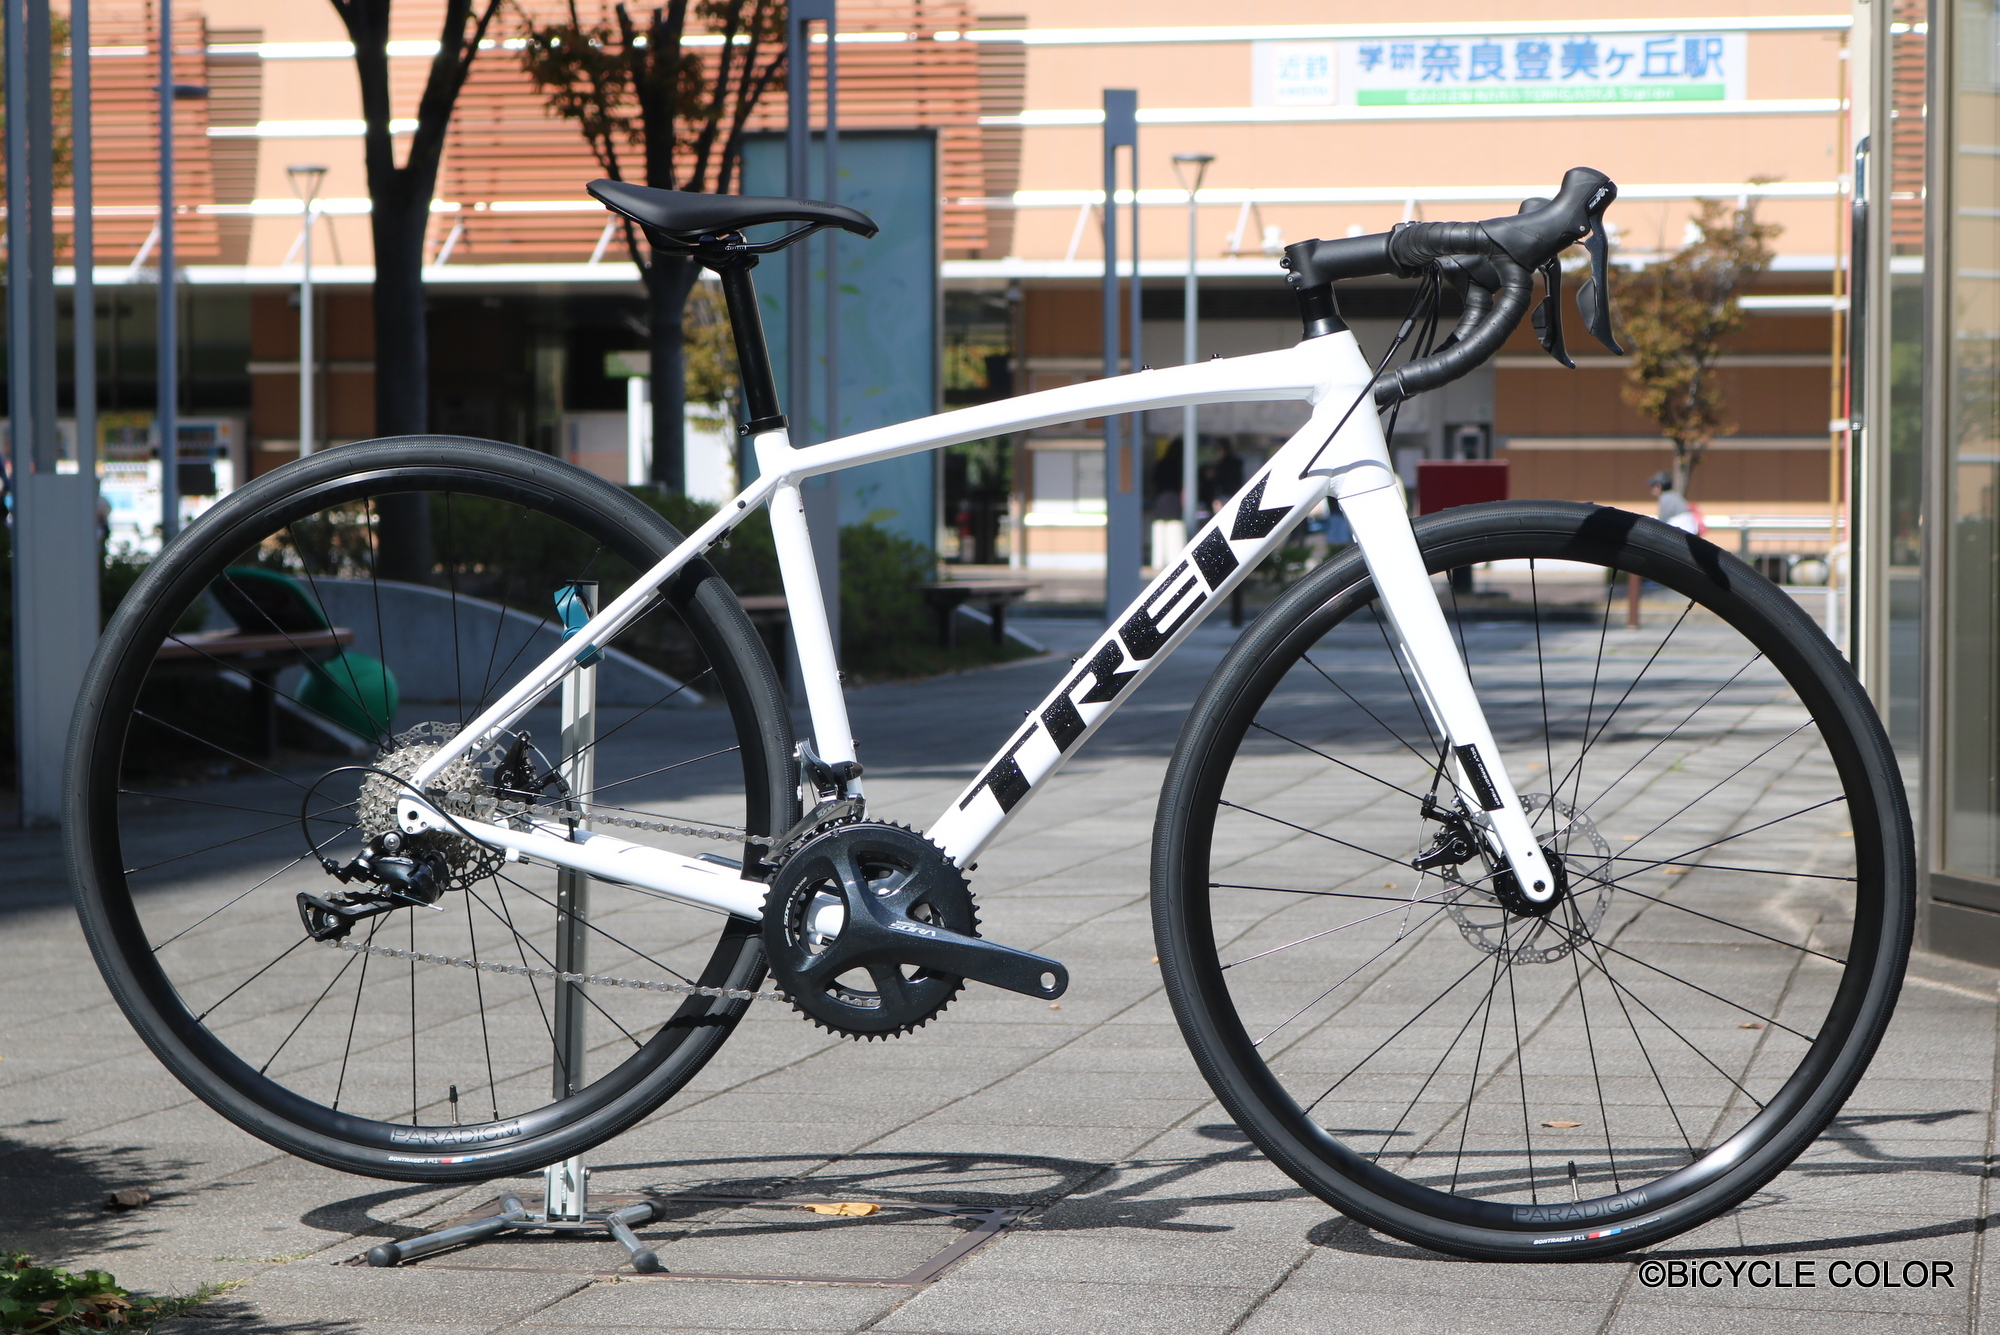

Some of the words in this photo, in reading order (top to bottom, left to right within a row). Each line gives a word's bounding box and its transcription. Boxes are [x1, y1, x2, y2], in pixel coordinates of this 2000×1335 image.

[959, 469, 1294, 815] TREK
[392, 1120, 522, 1144] PARADIGM
[387, 1155, 426, 1164] BONTRAGER
[1514, 1190, 1647, 1222] PARADIGM
[1533, 1236, 1573, 1246] BONTRAGER
